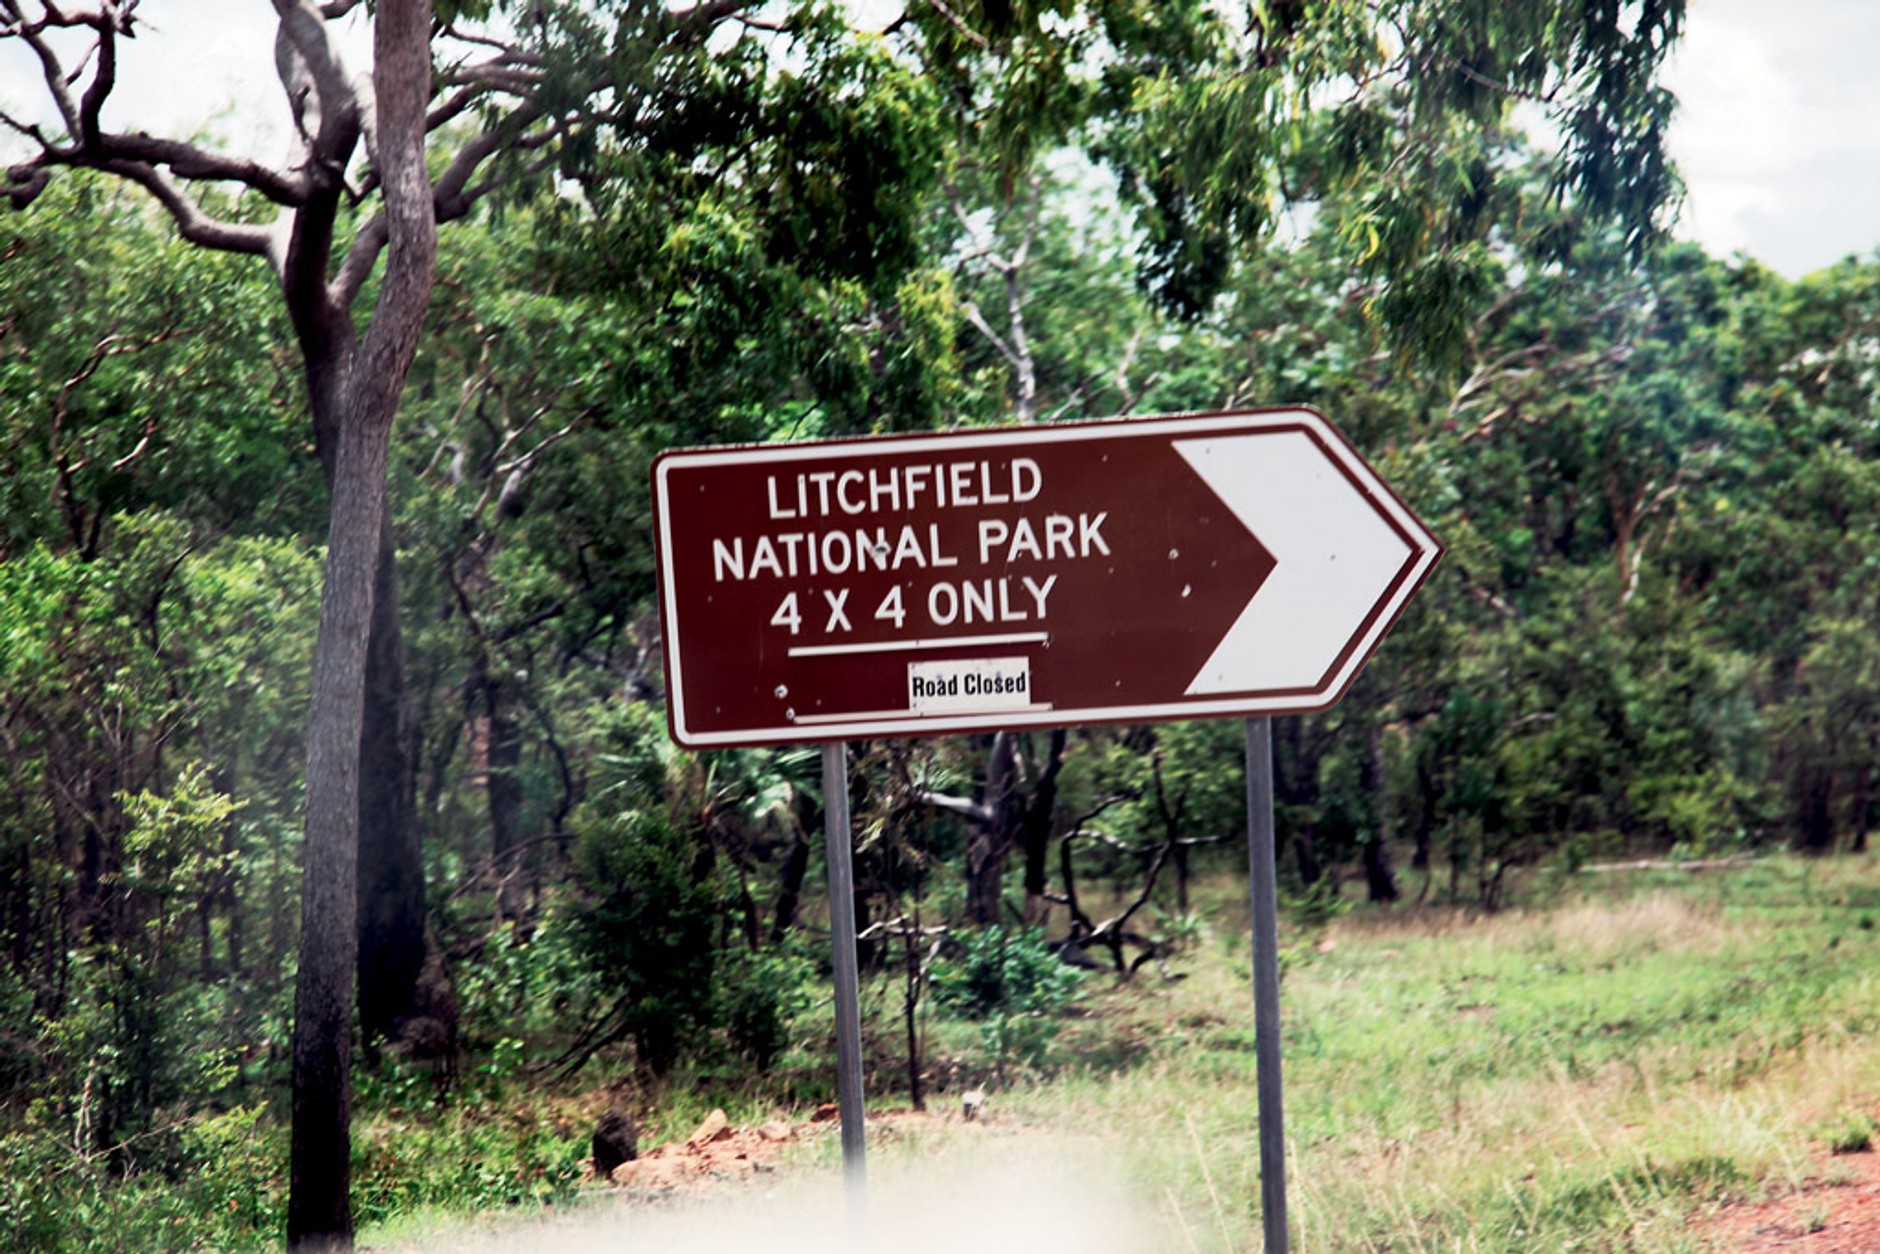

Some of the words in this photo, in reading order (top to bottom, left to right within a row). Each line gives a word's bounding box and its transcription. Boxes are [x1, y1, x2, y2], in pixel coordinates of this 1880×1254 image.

[767, 457, 1042, 519] LITCHFIELD
[712, 522, 958, 582] NATIONAL
[978, 512, 1111, 565] PARK
[770, 592, 802, 635] 4
[824, 588, 852, 633] X
[874, 584, 906, 629] 4
[928, 574, 1058, 627] ONLY
[911, 674, 959, 698] Road
[963, 671, 1027, 696] Closed
